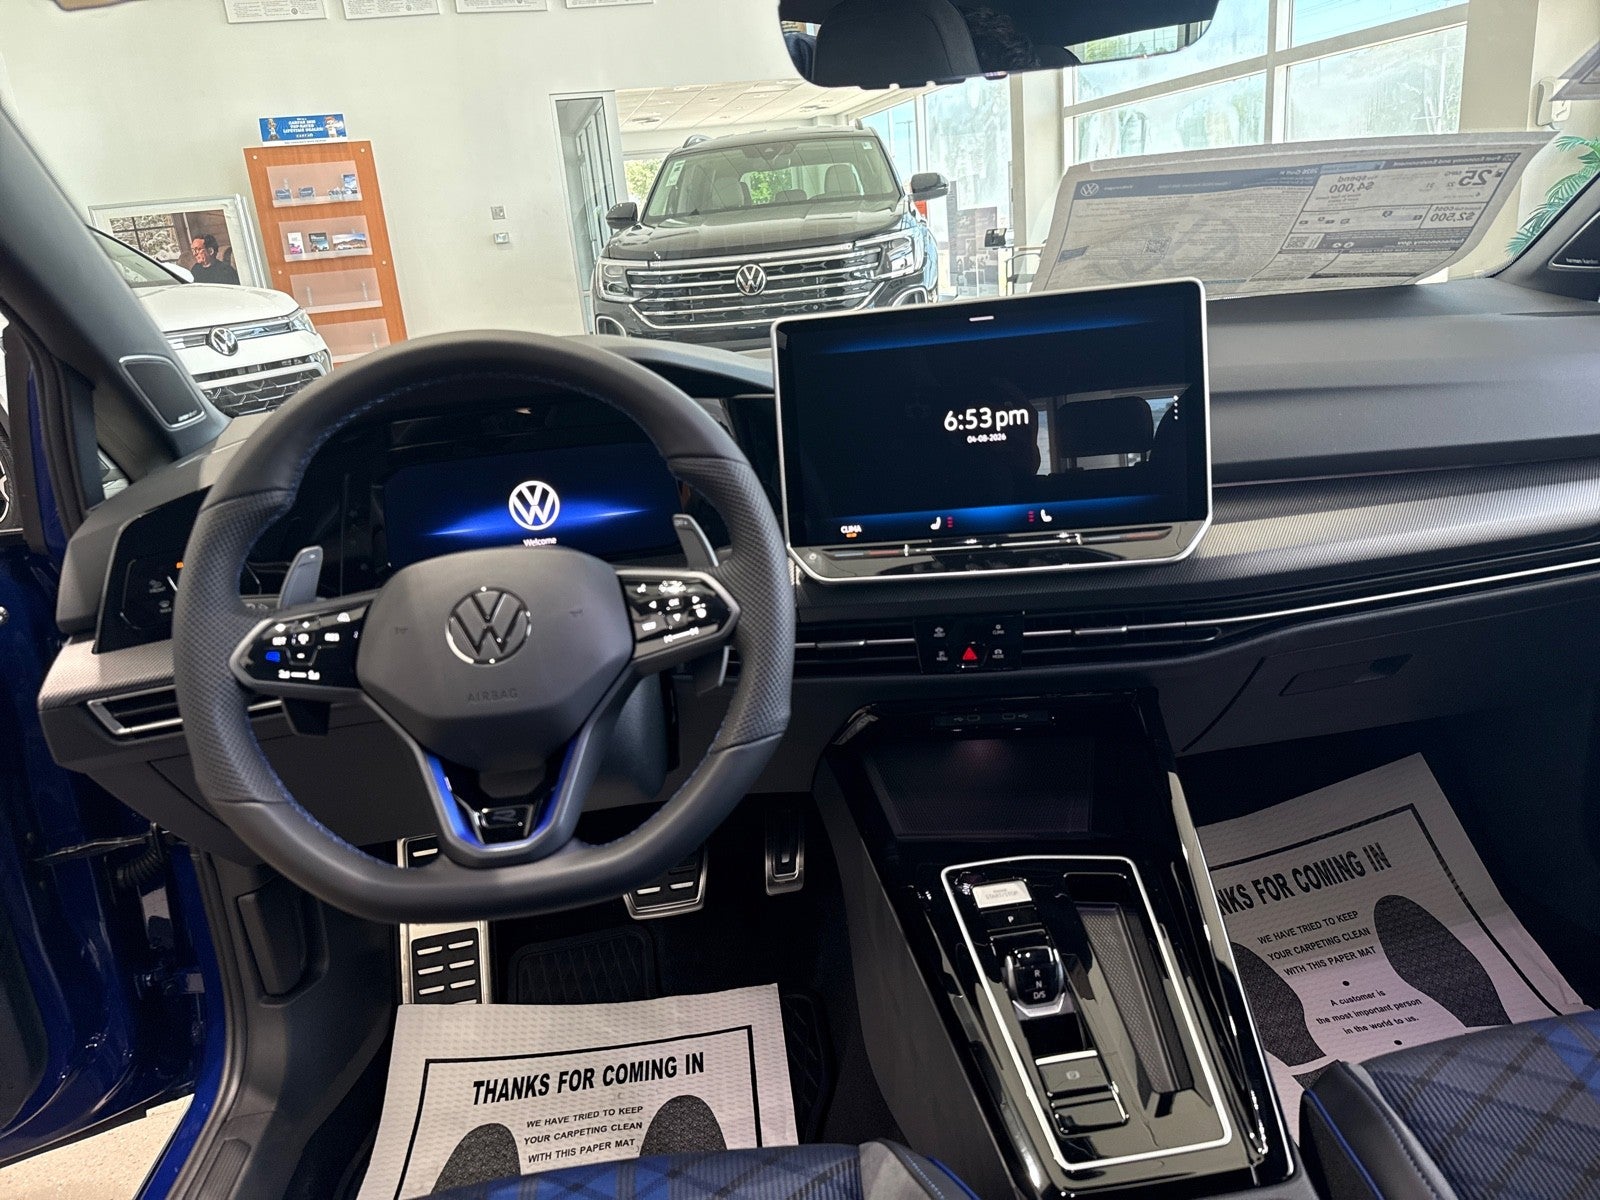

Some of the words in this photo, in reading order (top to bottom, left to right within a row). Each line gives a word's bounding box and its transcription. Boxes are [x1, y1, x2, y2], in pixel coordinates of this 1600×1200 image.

[944, 407, 992, 431] 6:53
[996, 409, 1029, 431] pm
[523, 537, 557, 547] Welcome
[467, 687, 518, 702] AIRBAG
[1251, 873, 1296, 904] FOR
[1292, 850, 1366, 893] COMING
[1362, 842, 1392, 872] IN
[1257, 934, 1272, 945] WE
[1273, 928, 1297, 940] HAVE
[1297, 921, 1322, 934] TRIED
[1322, 917, 1336, 927] TO
[1336, 910, 1358, 922] KEEP
[1267, 948, 1293, 961] YOUR
[1294, 936, 1341, 954] CARPETING
[1341, 927, 1371, 941] CLEAN
[1283, 964, 1307, 976] WITH
[1306, 959, 1327, 970] THIS
[1327, 951, 1357, 965] PAPER
[1356, 946, 1376, 958] MAT
[1034, 969, 1041, 978] R
[1035, 980, 1042, 988] N
[1033, 991, 1046, 1000] D/S
[1339, 992, 1376, 1005] customer
[1376, 989, 1386, 997] is
[1332, 1012, 1353, 1022] most
[1353, 1004, 1393, 1017] important
[1393, 999, 1423, 1011] person
[1369, 1019, 1394, 1029] world
[473, 1073, 550, 1106] THANKS
[557, 1068, 595, 1093] FOR
[603, 1056, 677, 1086] COMING
[686, 1052, 704, 1075] IN
[526, 1120, 541, 1128] WE
[544, 1116, 570, 1125] HAVE
[573, 1110, 599, 1121] TRIED
[603, 1108, 615, 1116] TO
[618, 1106, 643, 1115] KEEP
[524, 1135, 550, 1145] YOUR
[554, 1126, 607, 1140] CARPETING
[611, 1122, 642, 1131] CLEAN
[528, 1152, 552, 1163] WITH
[556, 1148, 576, 1158] THIS
[580, 1141, 612, 1154] PAPER
[615, 1138, 635, 1148] MAT
